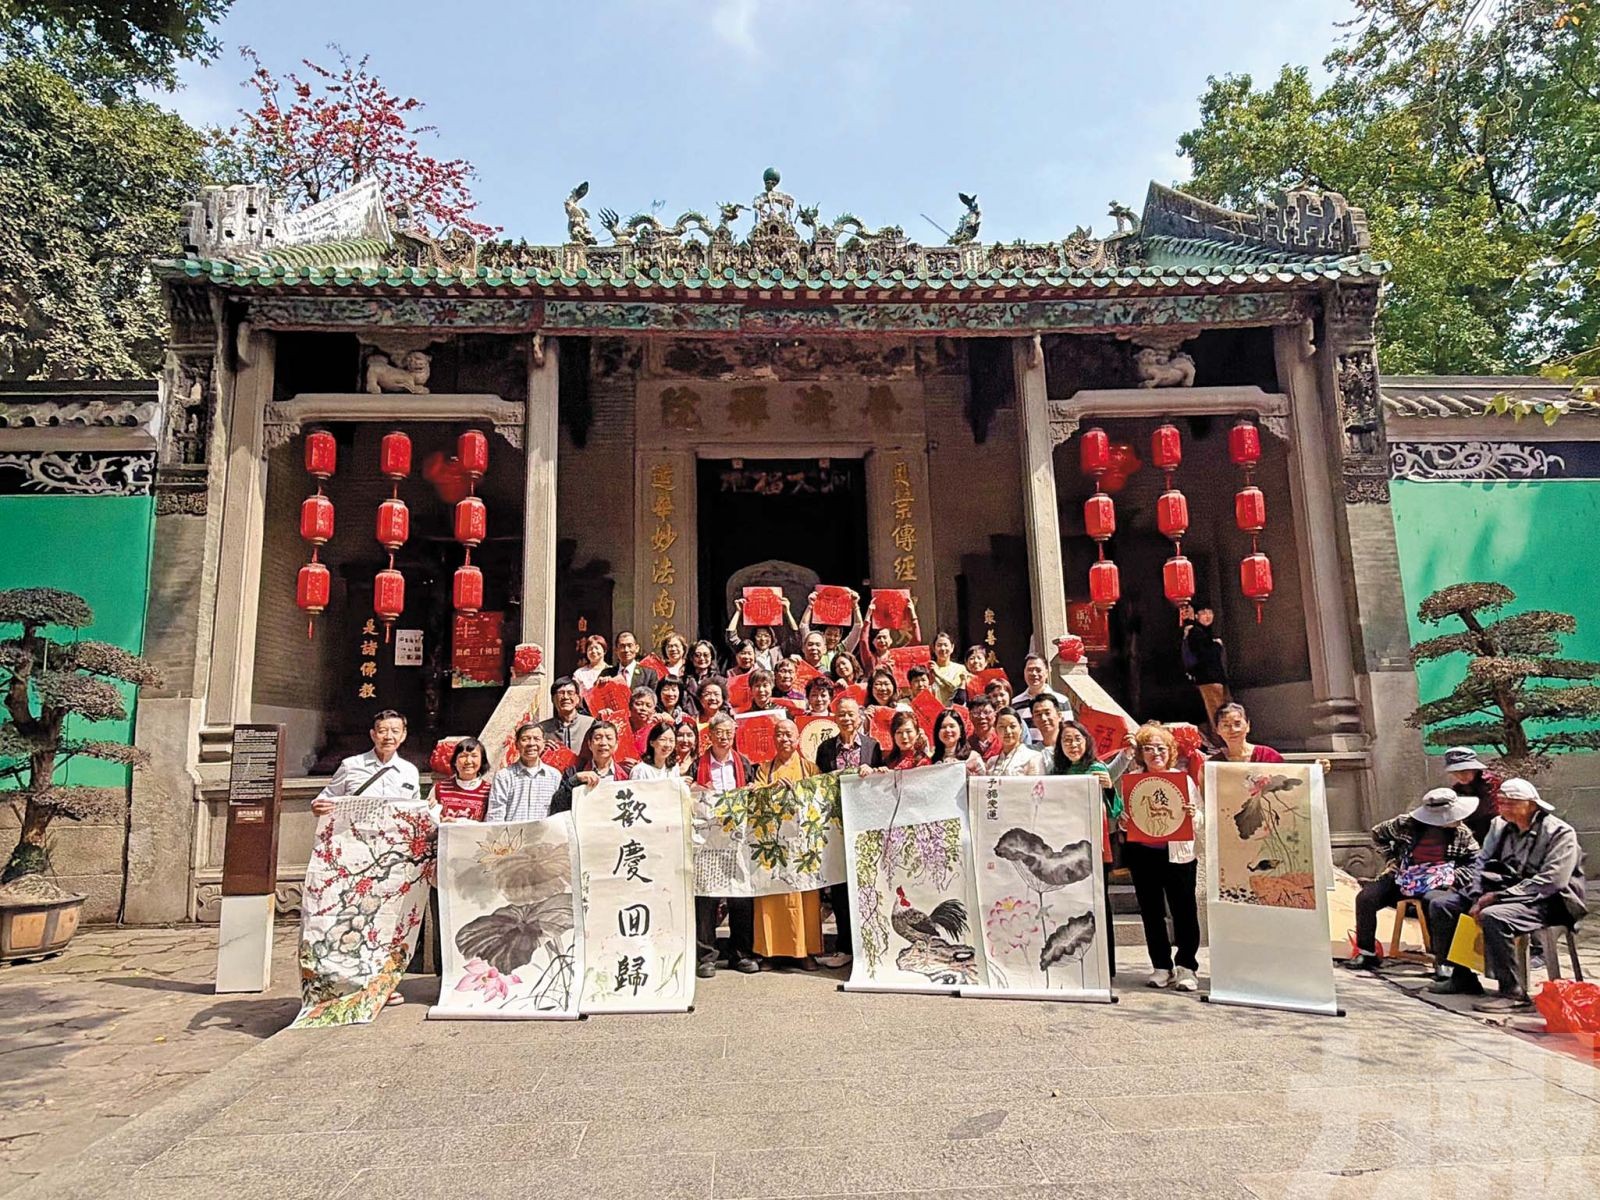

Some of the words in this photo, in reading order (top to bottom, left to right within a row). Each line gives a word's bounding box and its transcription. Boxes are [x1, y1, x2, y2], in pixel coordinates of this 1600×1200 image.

[358, 618, 379, 698] 是諸佛教
[611, 788, 653, 997] 歡慶回歸
